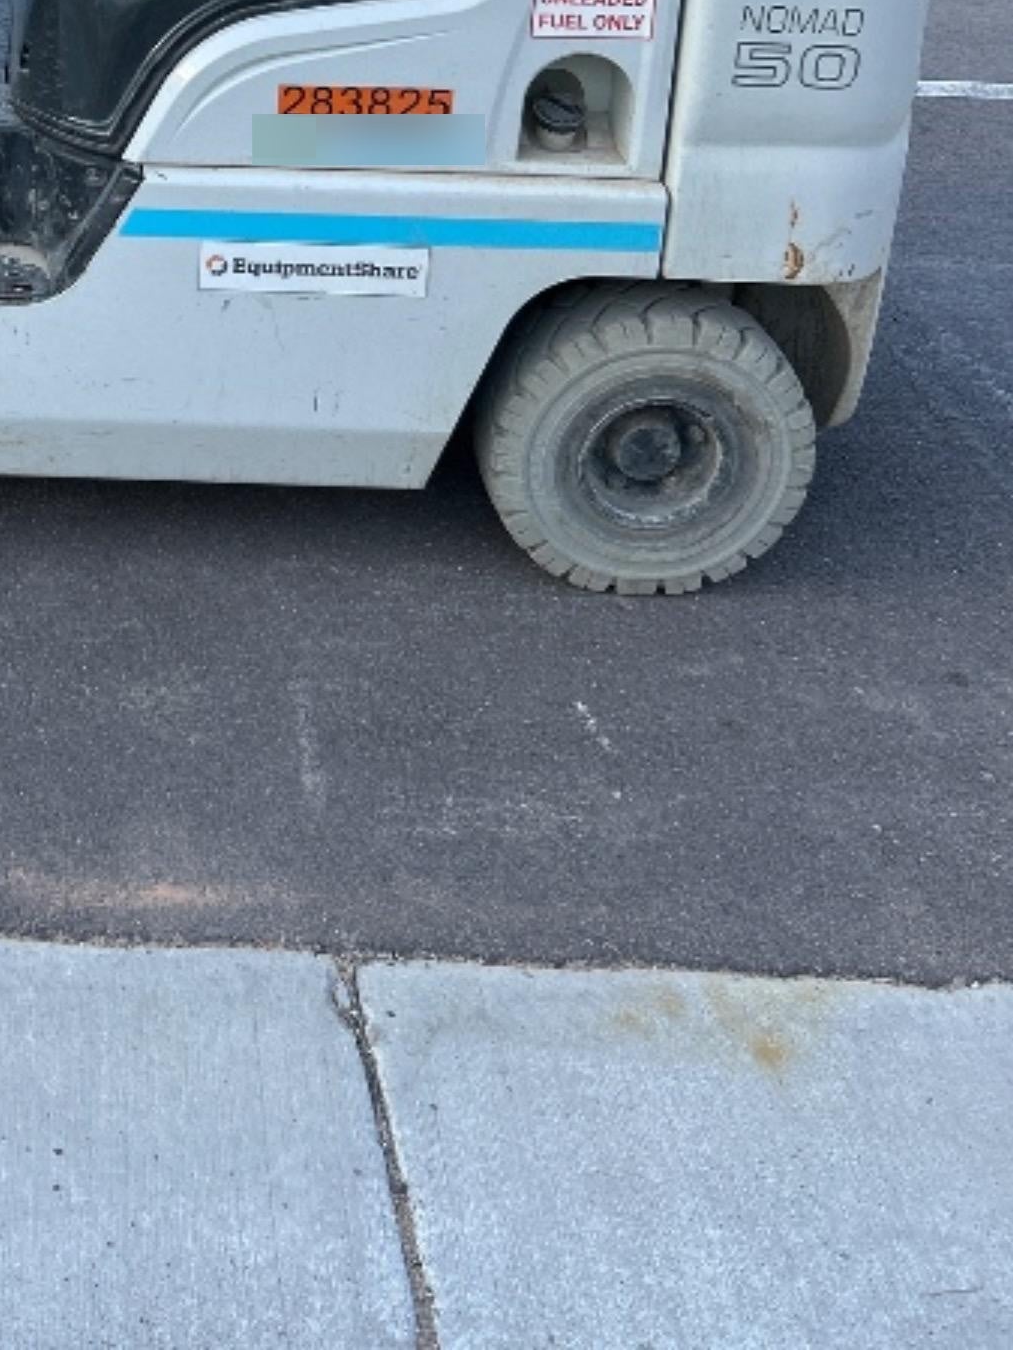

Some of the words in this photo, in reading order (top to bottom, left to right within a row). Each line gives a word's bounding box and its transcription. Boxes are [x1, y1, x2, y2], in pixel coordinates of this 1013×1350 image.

[538, 13, 588, 30] FUEL
[592, 13, 645, 31] ONLY
[739, 5, 864, 36] NOMAD
[731, 41, 861, 91] 50
[283, 86, 451, 115] 283825
[232, 257, 420, 280] EquipmentShare
